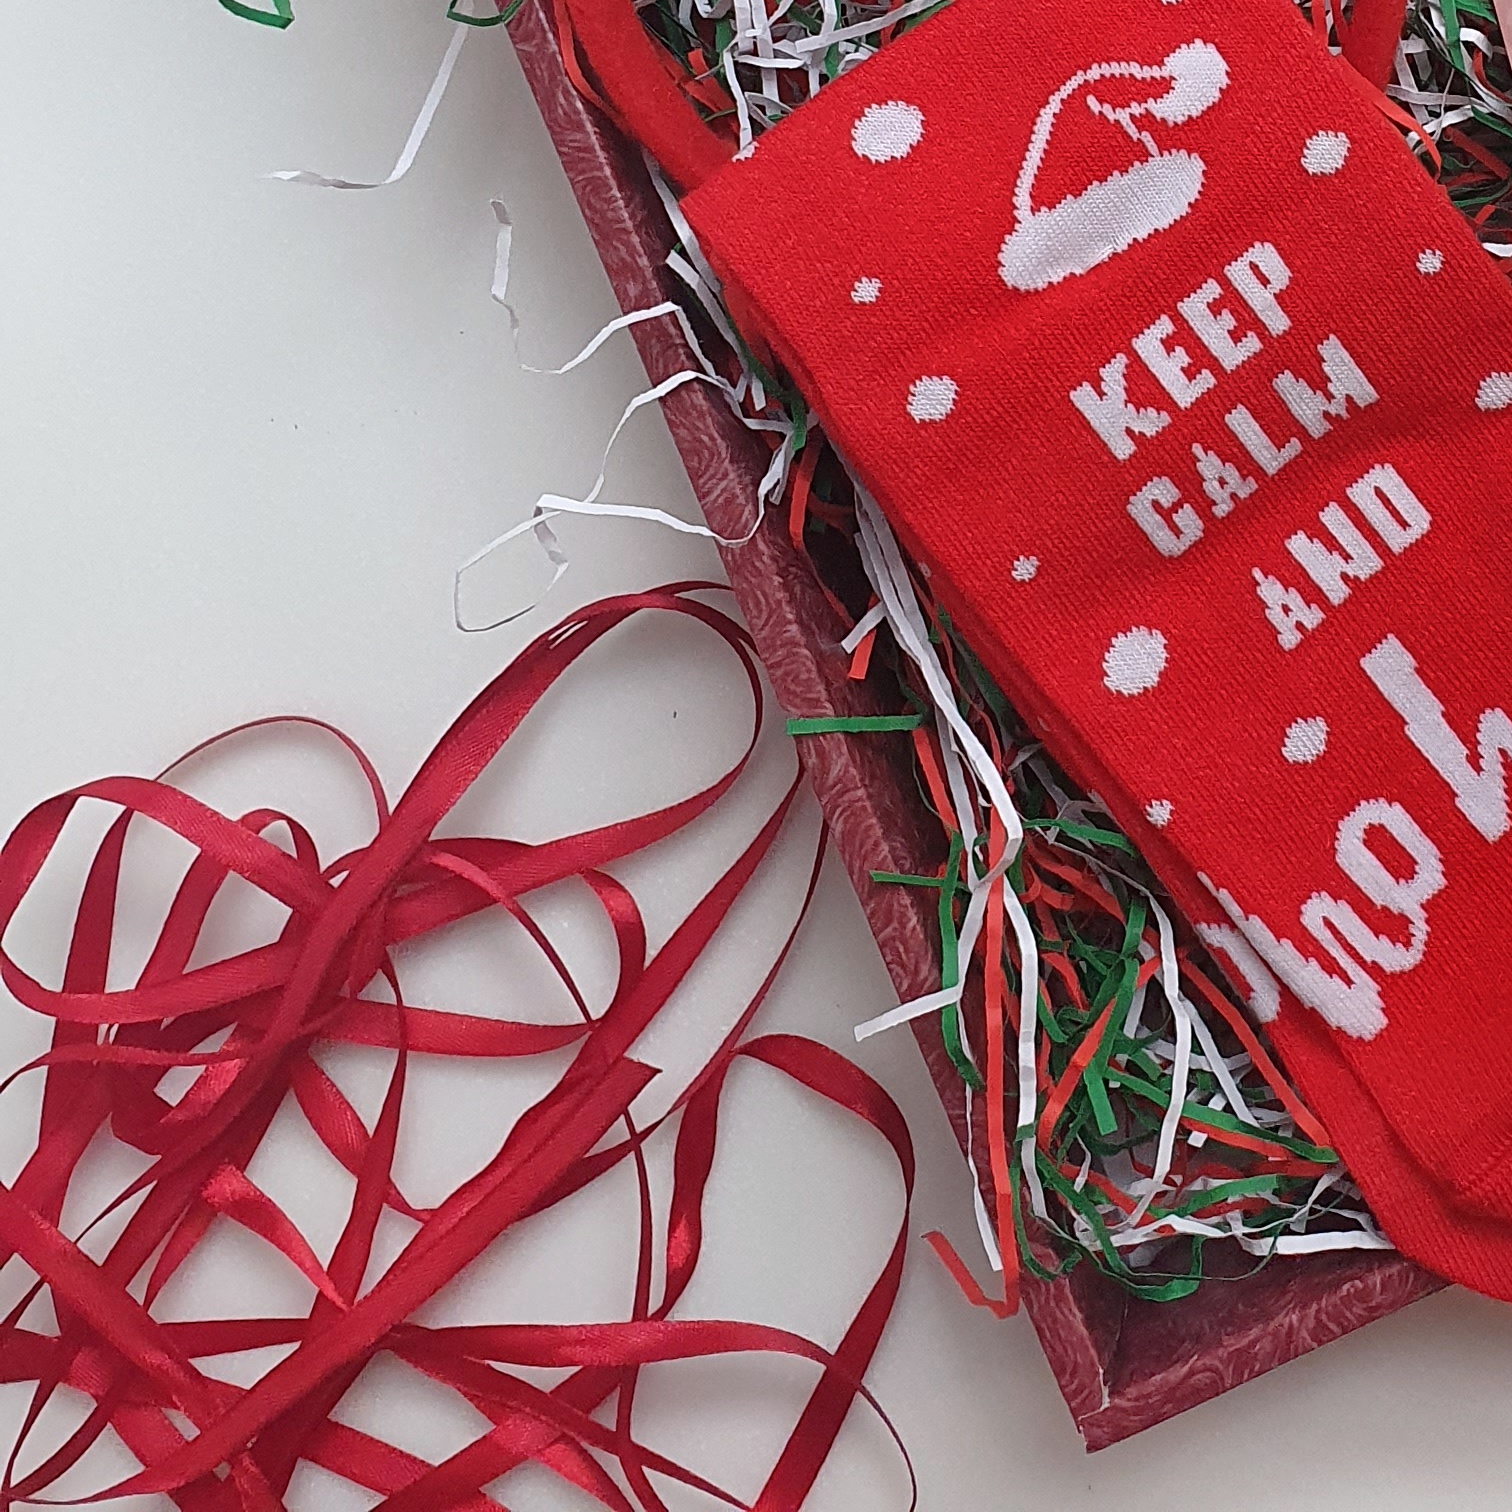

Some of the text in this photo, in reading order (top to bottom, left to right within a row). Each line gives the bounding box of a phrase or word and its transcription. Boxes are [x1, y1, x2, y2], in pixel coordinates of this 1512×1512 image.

[1069, 242, 1293, 461] KEEP
[1127, 334, 1379, 557] CALM
[1253, 464, 1433, 651] AND
